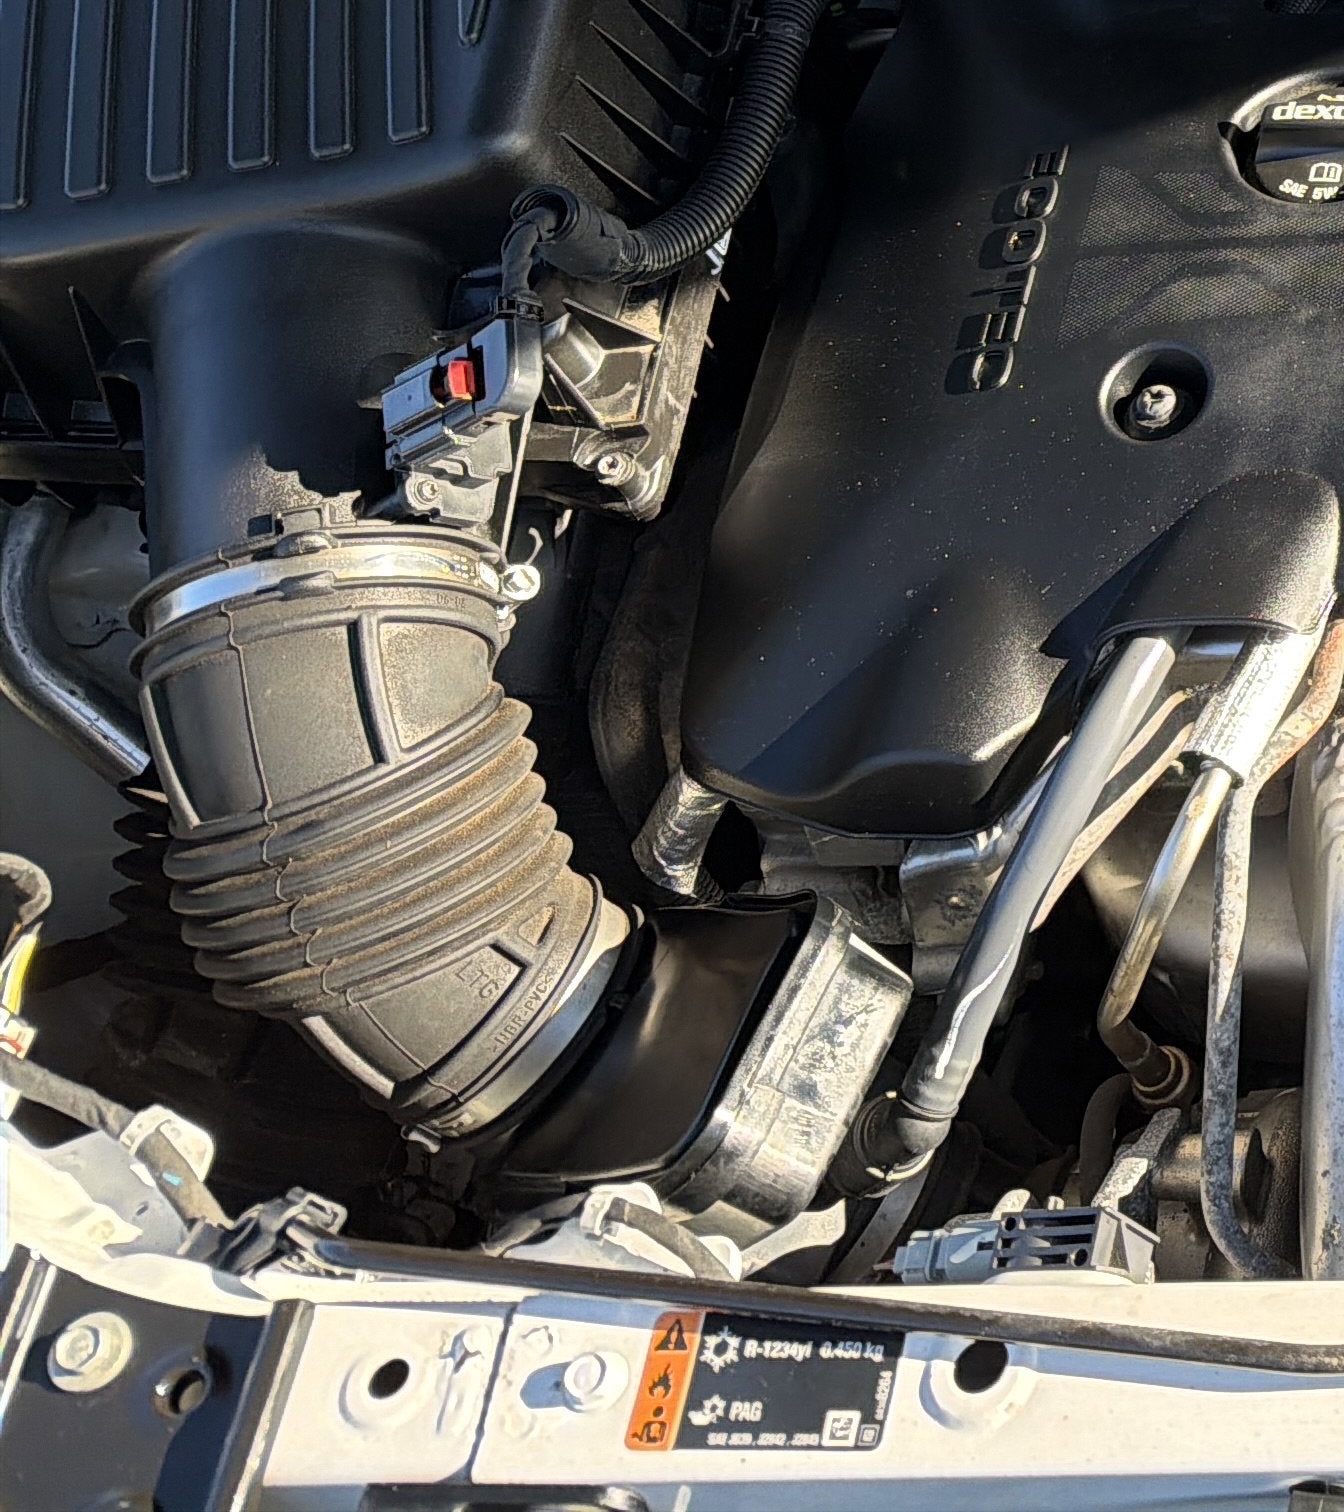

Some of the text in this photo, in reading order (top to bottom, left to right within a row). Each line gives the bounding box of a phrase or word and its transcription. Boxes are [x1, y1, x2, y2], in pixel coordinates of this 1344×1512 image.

[1278, 178, 1309, 198] SAE
[964, 143, 1070, 393] ECOTEC
[728, 1401, 763, 1422] PAG
